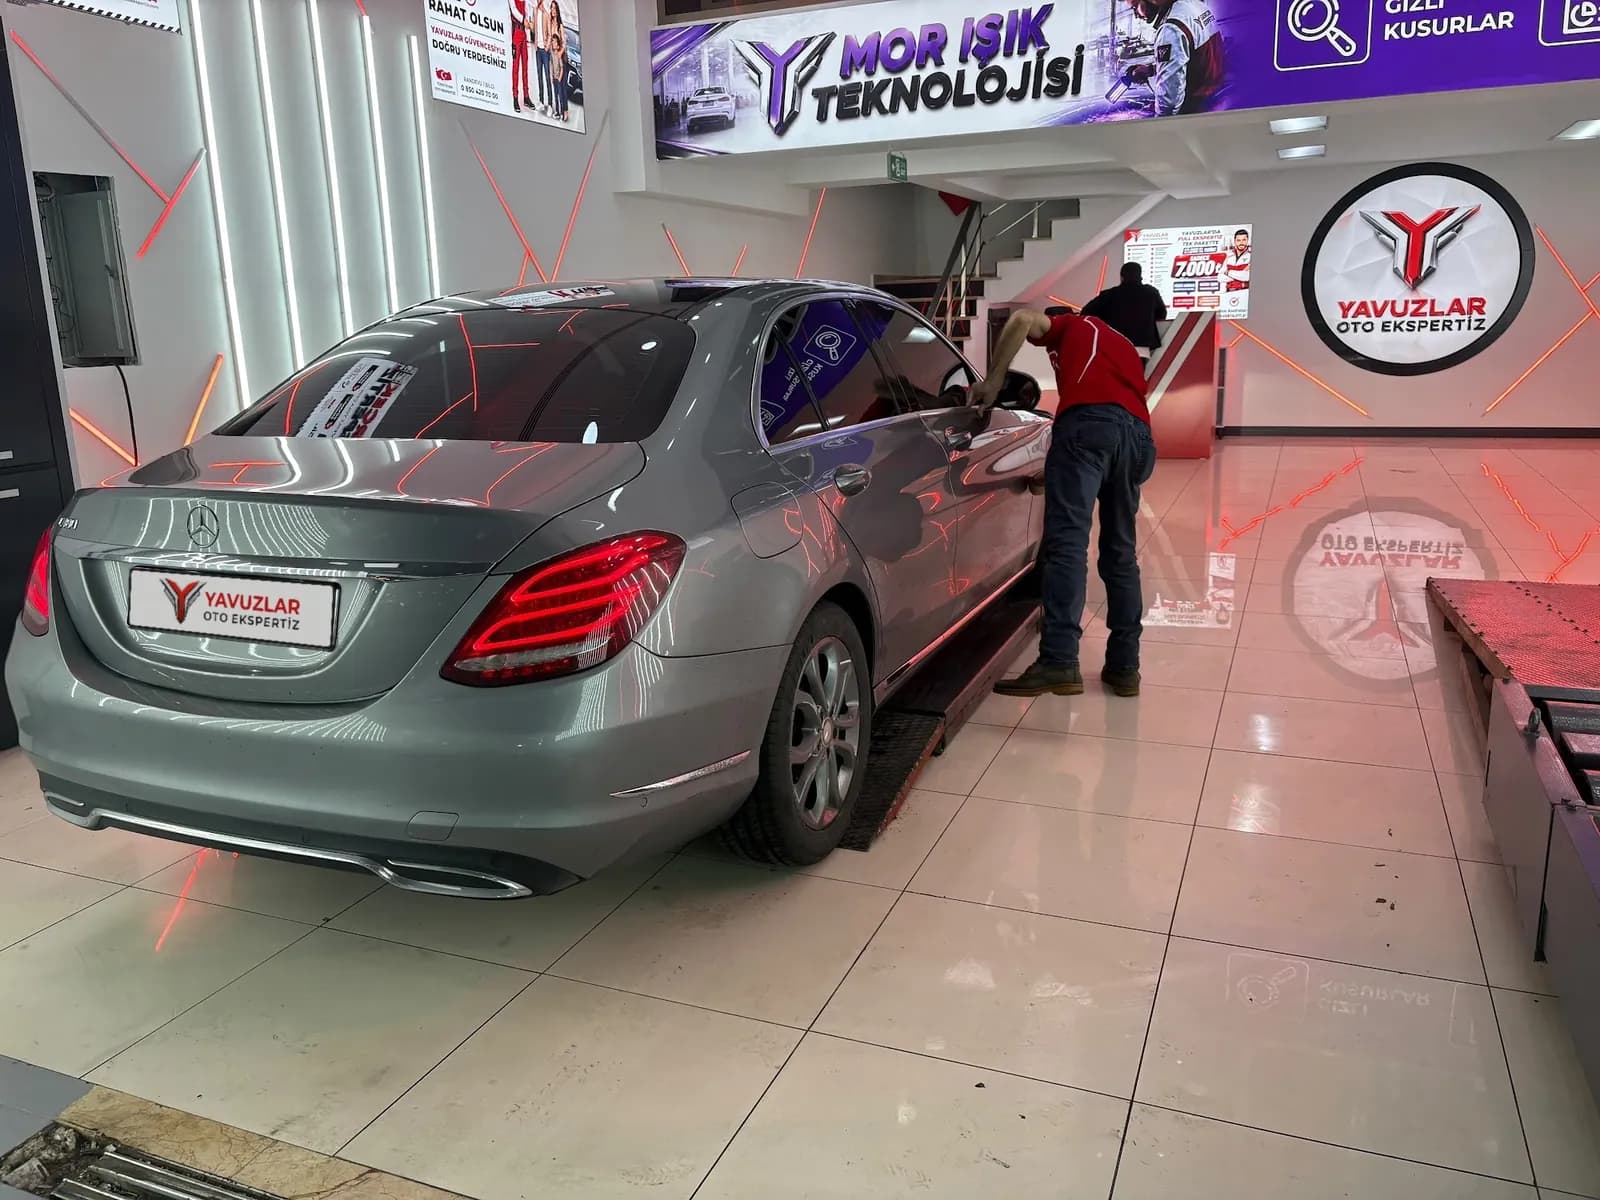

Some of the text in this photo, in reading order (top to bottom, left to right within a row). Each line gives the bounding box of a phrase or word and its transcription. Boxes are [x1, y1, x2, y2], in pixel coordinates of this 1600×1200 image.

[429, 0, 504, 34] RAHAT OLSUN
[1384, 11, 1514, 41] KUSURLAR
[431, 25, 463, 41] YAVUZLAR
[839, 2, 1055, 80] MOR IŞIK
[432, 39, 507, 69] DOĞRU YERDESİNİZ!
[810, 44, 1087, 123] TEKNOLOJİSİ
[1337, 297, 1487, 319] YAVUZLAR
[1337, 316, 1486, 334] OTO EKSPERTİZ
[205, 591, 301, 615] YAVUZLAR
[203, 611, 301, 630] OTO EKSPERTİZ
